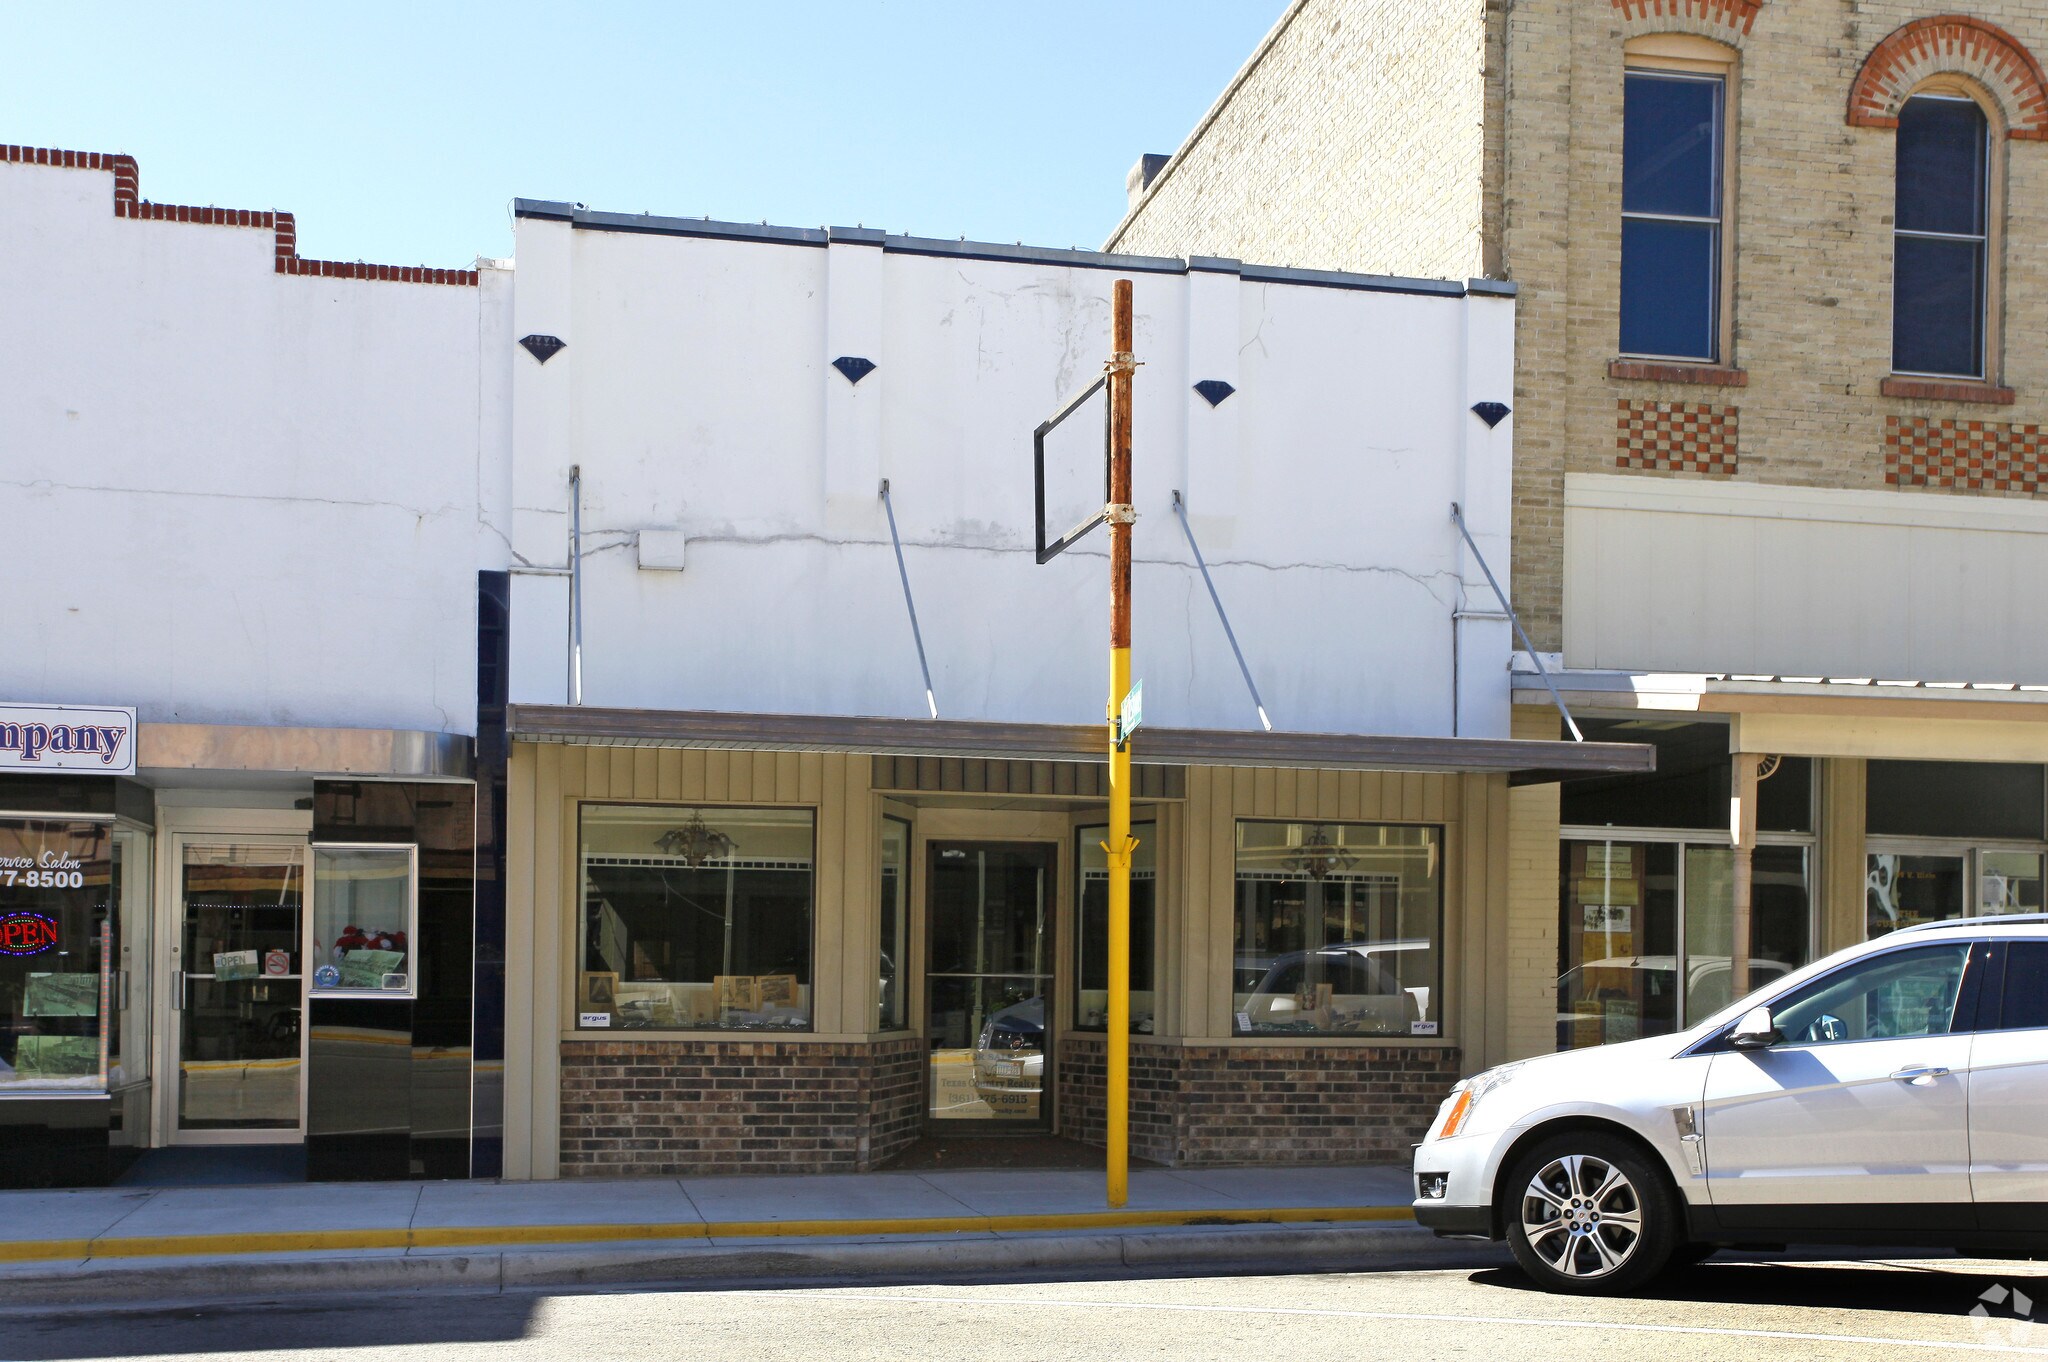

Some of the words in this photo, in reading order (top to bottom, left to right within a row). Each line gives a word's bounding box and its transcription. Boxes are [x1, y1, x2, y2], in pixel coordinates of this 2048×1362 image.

[40, 850, 81, 869] Salon
[0, 920, 58, 945] PEN
[221, 955, 246, 967] OPEN
[941, 1078, 967, 1087] Texas
[968, 1078, 1006, 1089] Country
[1007, 1079, 1037, 1088] Realty
[948, 1093, 974, 1104] (361)
